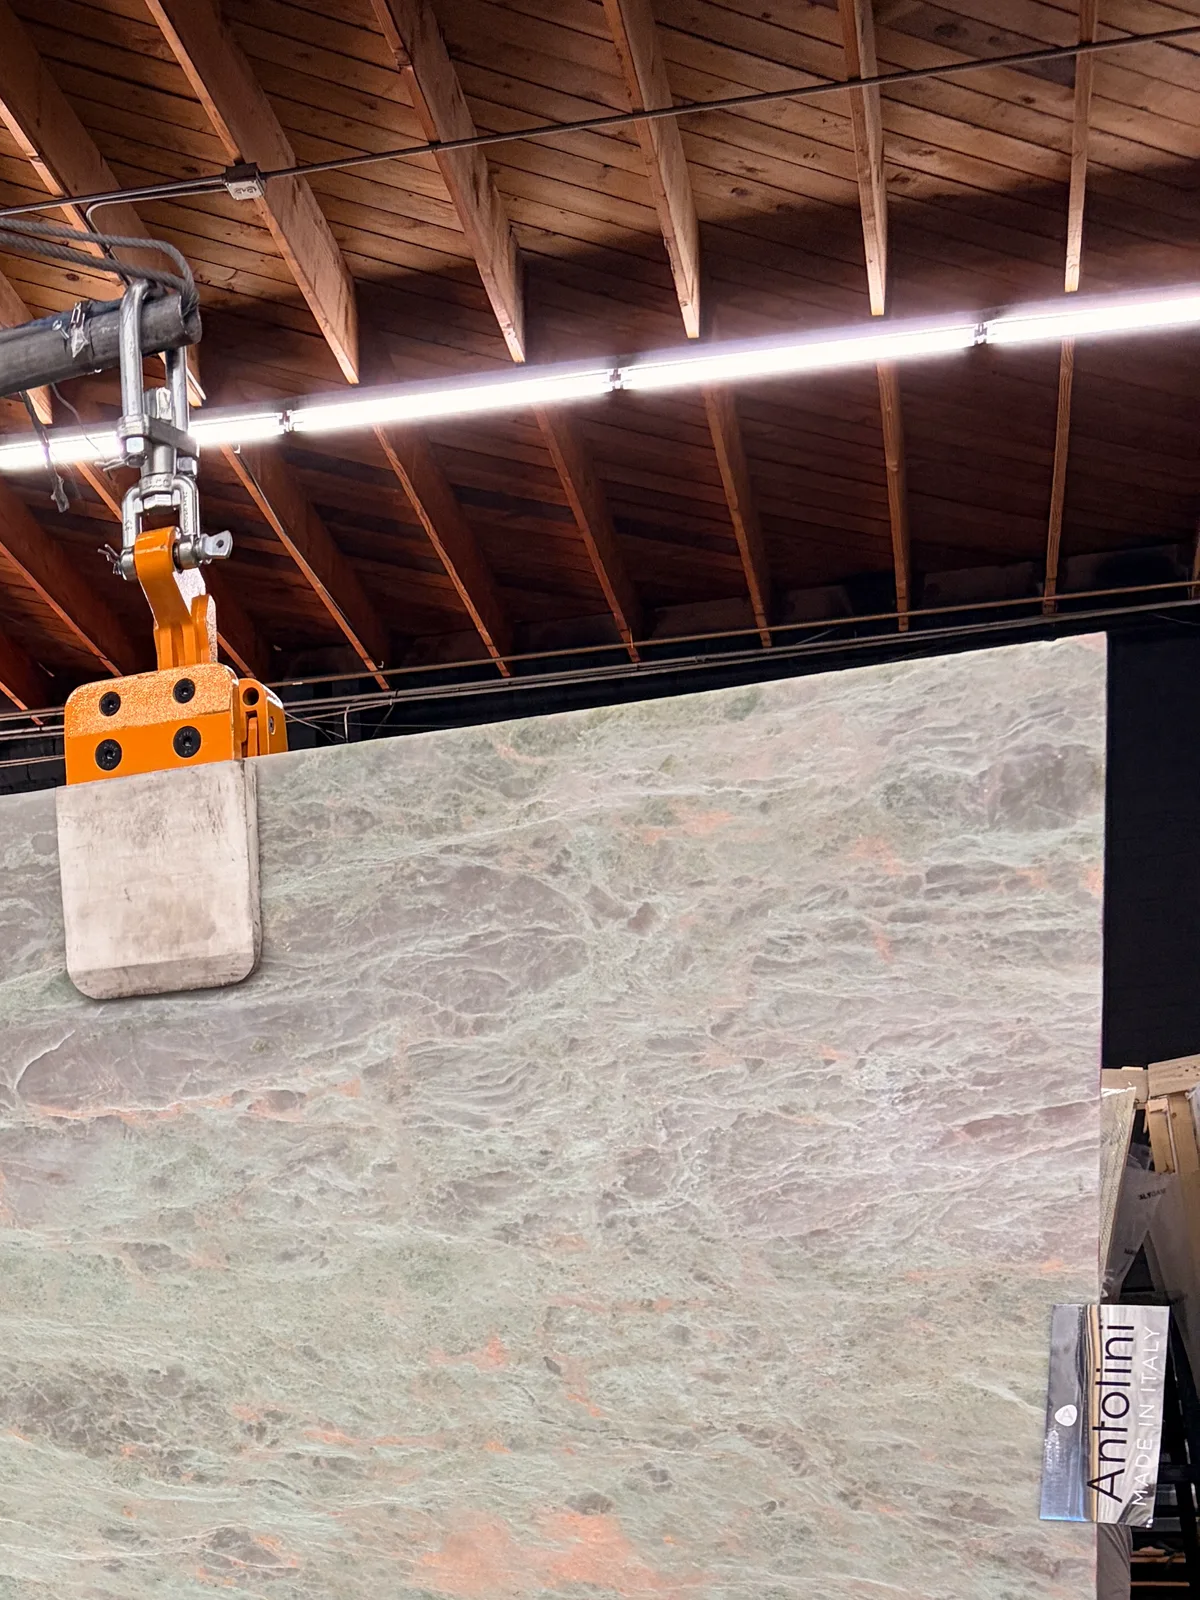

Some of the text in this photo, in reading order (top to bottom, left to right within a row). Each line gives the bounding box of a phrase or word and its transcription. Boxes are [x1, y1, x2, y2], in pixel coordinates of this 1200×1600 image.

[1086, 1325, 1135, 1503] Antolini
[1131, 1326, 1161, 1506] MADE IN ITALY
